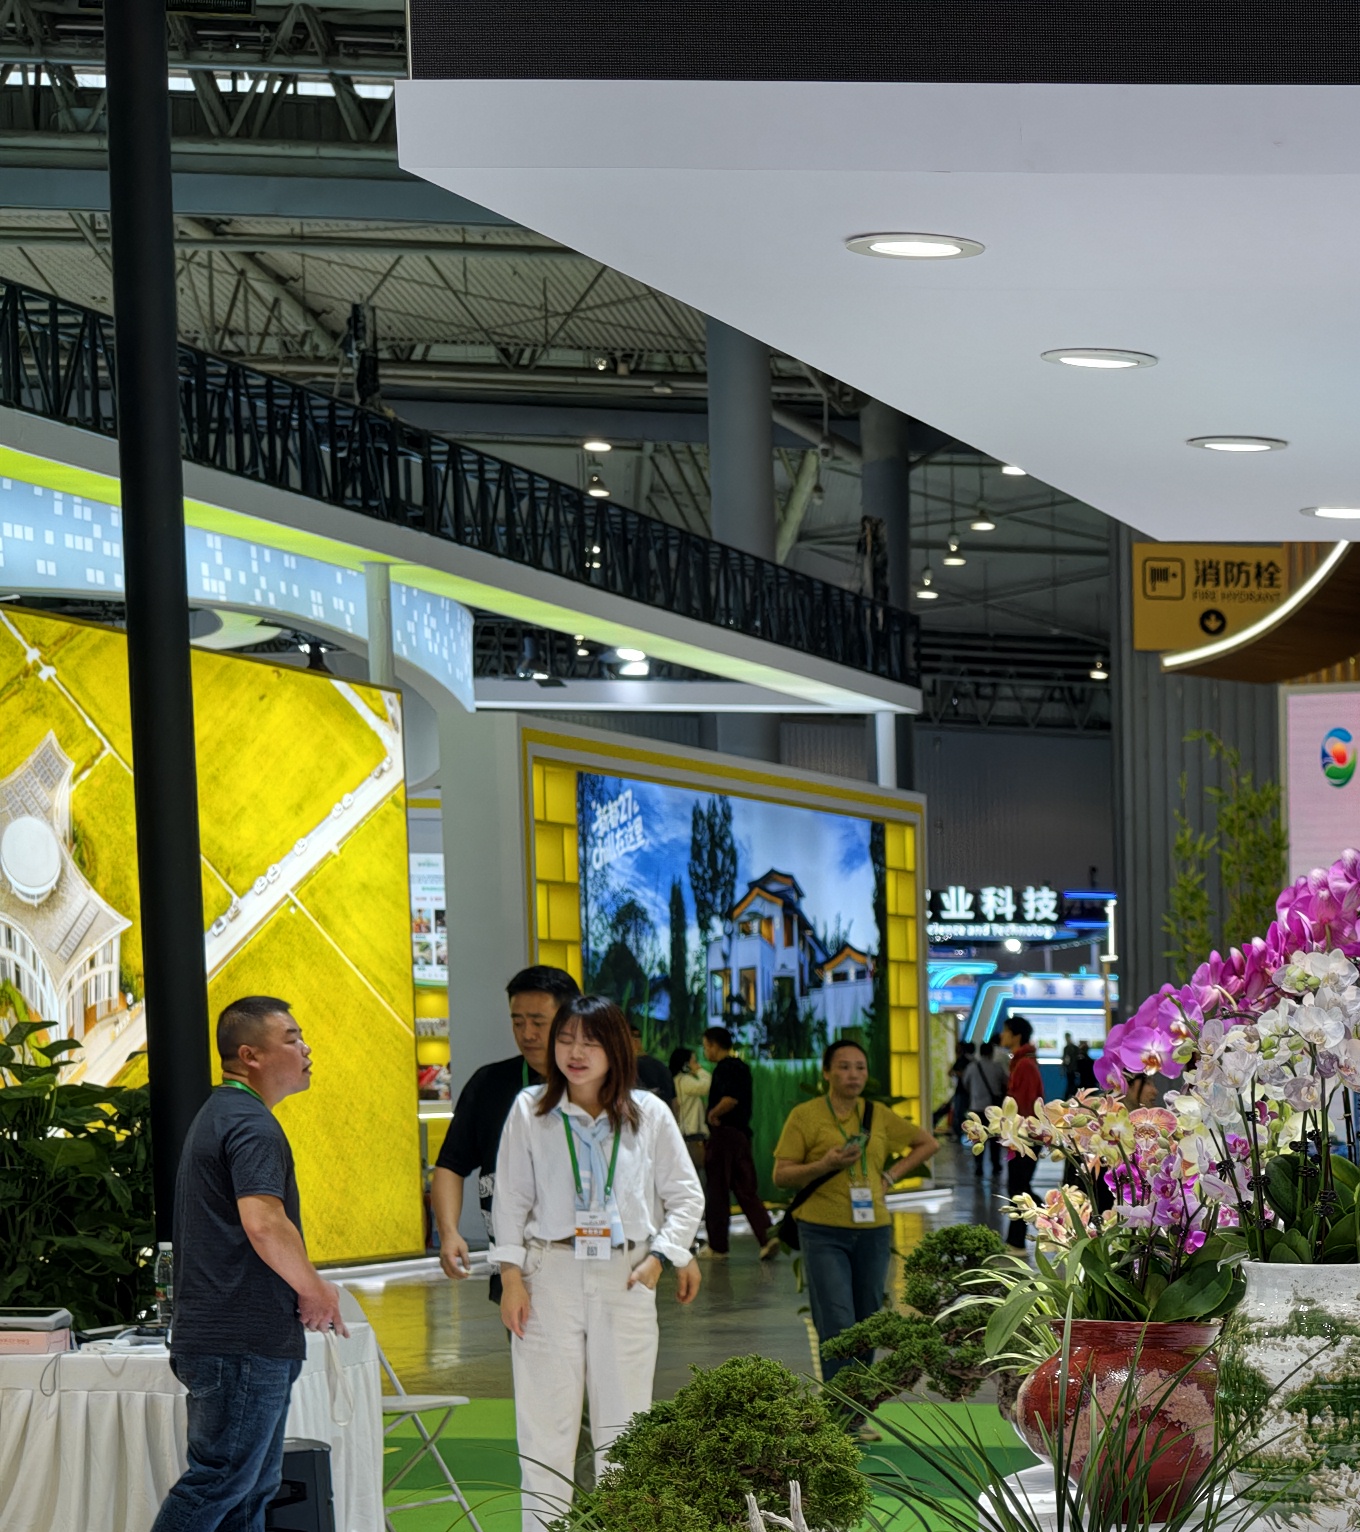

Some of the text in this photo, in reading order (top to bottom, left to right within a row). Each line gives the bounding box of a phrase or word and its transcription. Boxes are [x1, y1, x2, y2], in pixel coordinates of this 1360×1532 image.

[1194, 559, 1282, 589] 消防栓
[926, 885, 1058, 921] 业科技
